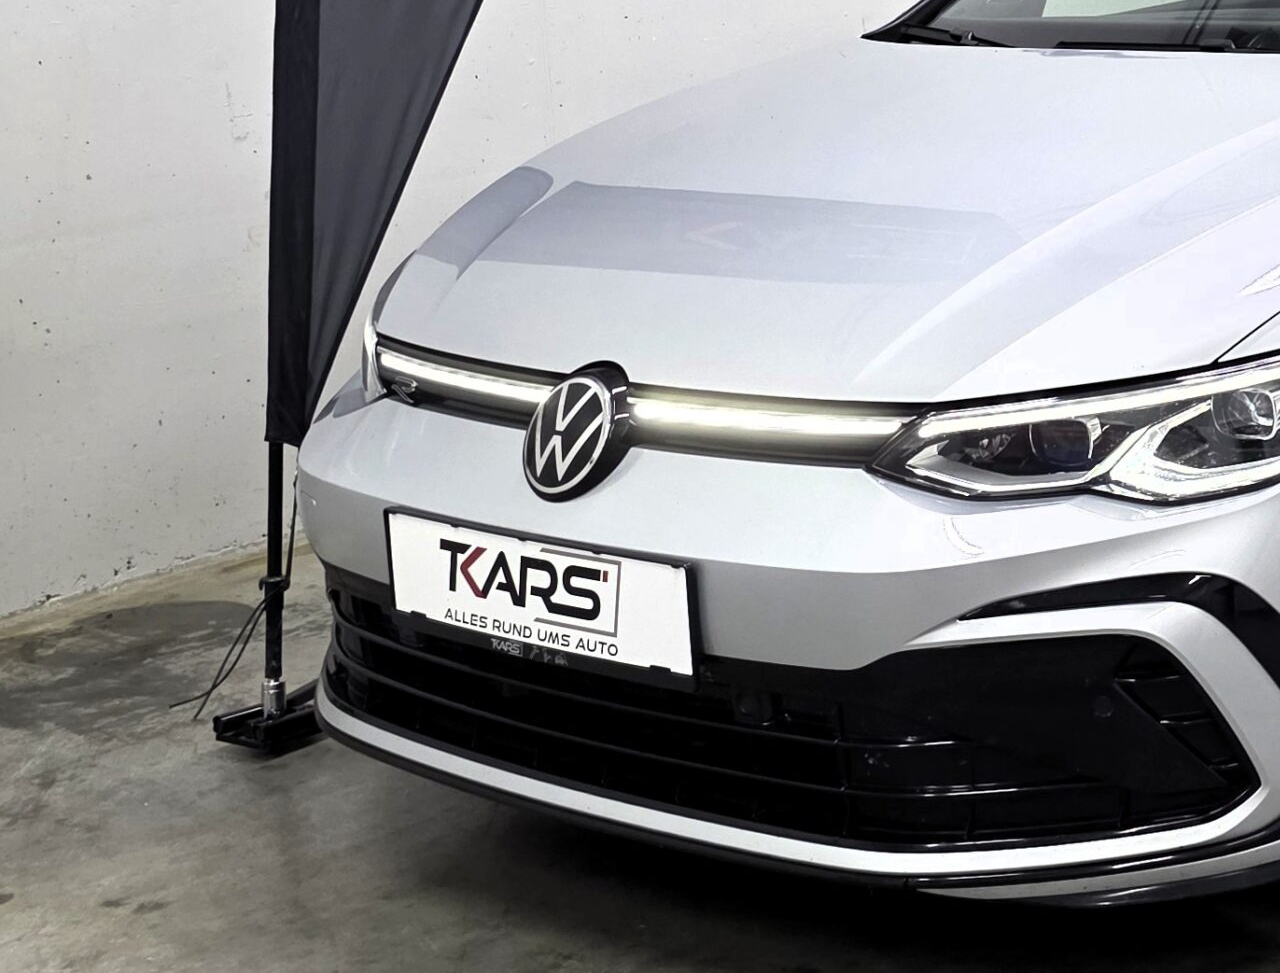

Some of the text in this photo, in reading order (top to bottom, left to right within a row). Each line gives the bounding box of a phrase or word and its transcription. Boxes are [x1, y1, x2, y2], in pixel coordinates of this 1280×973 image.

[444, 607, 618, 657] ALLES RUND UMS AUTO
